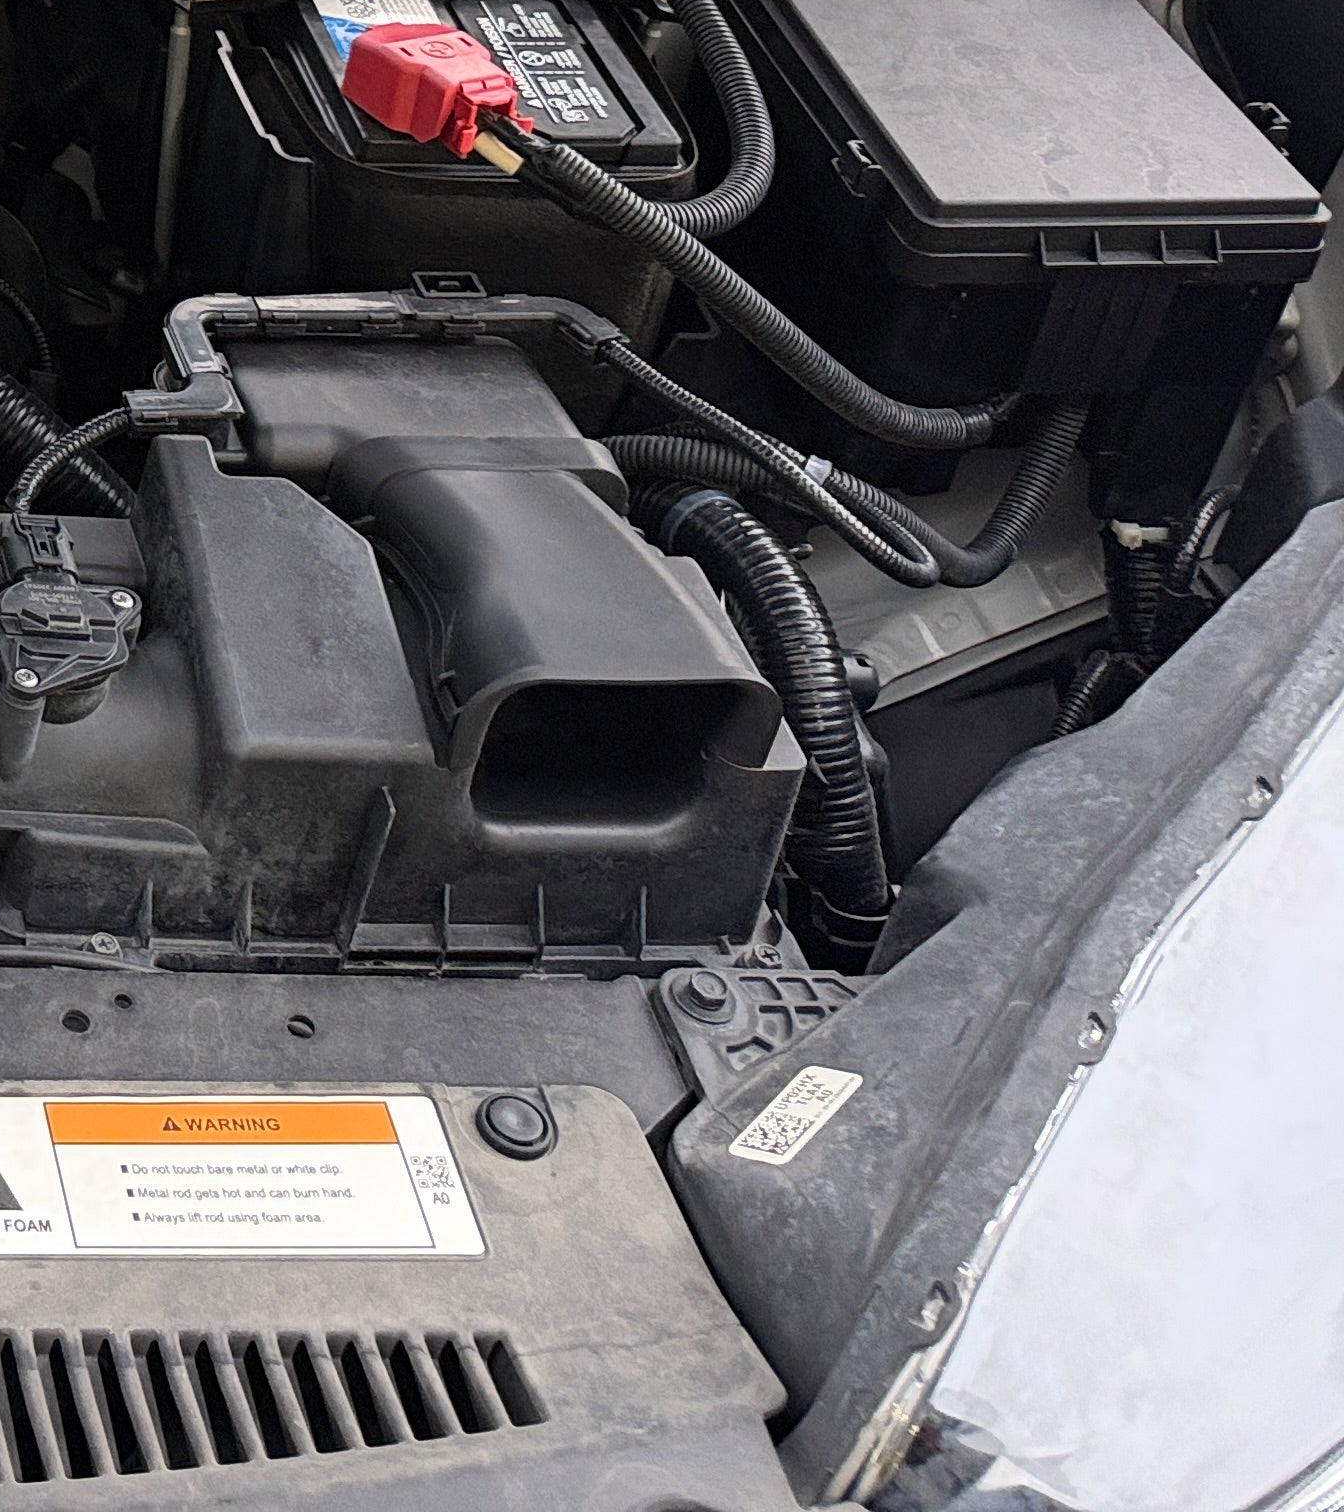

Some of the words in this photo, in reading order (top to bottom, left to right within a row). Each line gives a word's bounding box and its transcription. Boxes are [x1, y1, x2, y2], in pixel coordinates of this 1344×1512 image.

[184, 1117, 281, 1132] WARNING
[131, 1164, 148, 1175] Do
[151, 1165, 170, 1175] not
[172, 1164, 205, 1175] touch
[206, 1164, 234, 1175] bare
[236, 1164, 269, 1175] metal
[271, 1166, 283, 1175] or
[285, 1164, 317, 1175] white
[137, 1187, 170, 1199] Metal
[172, 1188, 192, 1199] rod
[194, 1188, 220, 1201] gets
[222, 1188, 242, 1199] hot
[244, 1188, 266, 1199] and
[269, 1189, 291, 1199] can
[5, 1218, 52, 1233] FOAM
[143, 1212, 186, 1225] Always
[187, 1212, 203, 1223] lift
[205, 1212, 225, 1223] rod
[227, 1212, 260, 1225] using
[261, 1212, 292, 1223] foam
